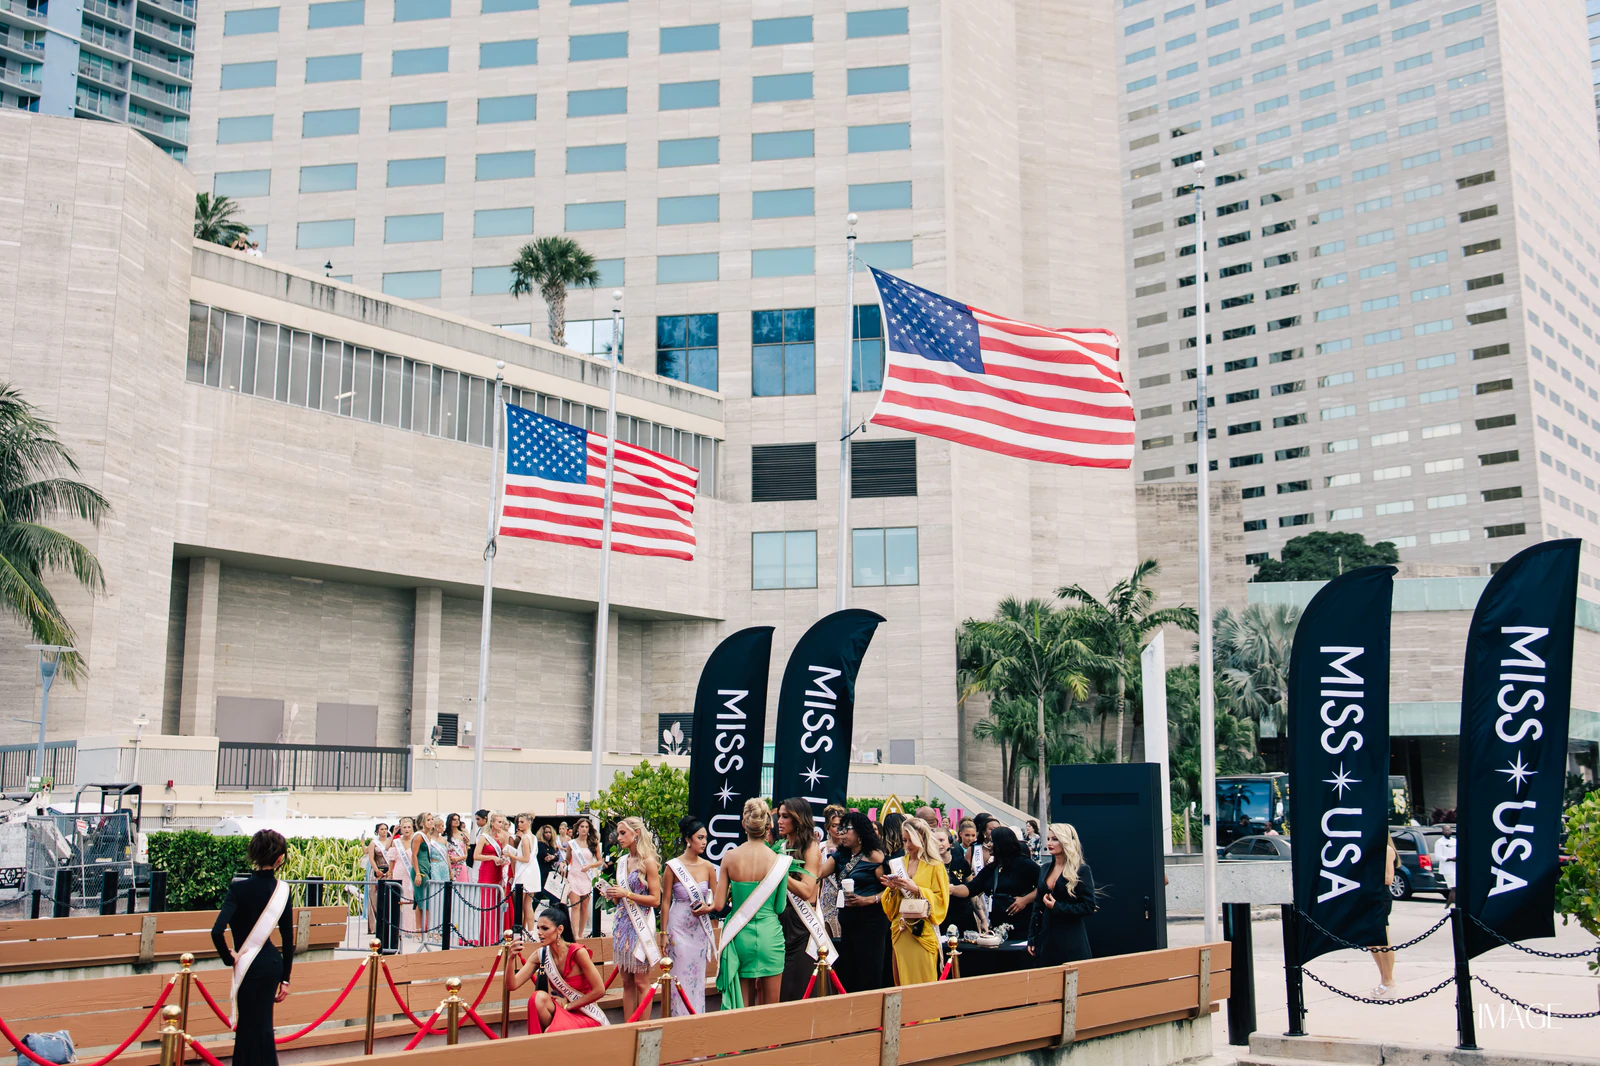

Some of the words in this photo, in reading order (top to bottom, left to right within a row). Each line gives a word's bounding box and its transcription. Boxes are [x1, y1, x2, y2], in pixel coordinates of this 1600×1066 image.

[801, 665, 842, 754] MISS
[1319, 646, 1364, 754] MISS
[1495, 626, 1549, 743] MISS
[714, 689, 749, 774] MISS
[676, 866, 690, 883] MISS
[705, 814, 741, 882] US
[1317, 807, 1362, 904] USA
[1487, 800, 1537, 897] USA
[635, 914, 646, 932] USA
[792, 894, 815, 924] DAKOTA
[811, 922, 824, 939] USA
[544, 954, 554, 974] MISS
[553, 976, 574, 998] RHODE
